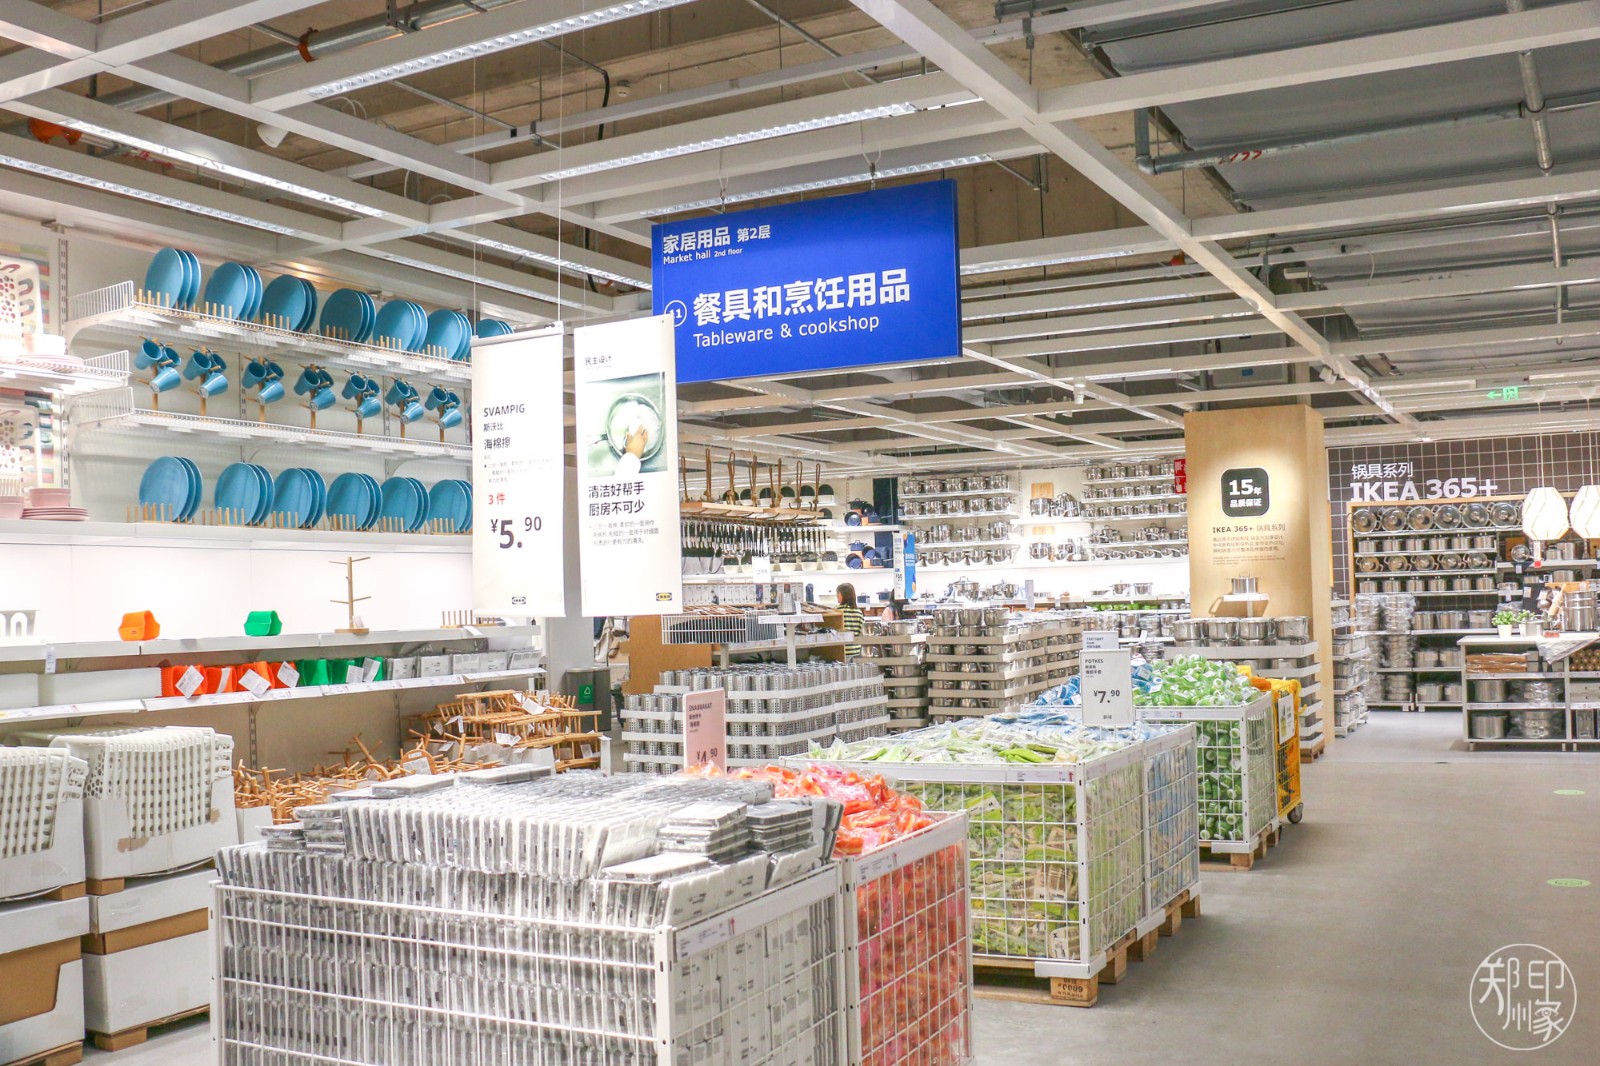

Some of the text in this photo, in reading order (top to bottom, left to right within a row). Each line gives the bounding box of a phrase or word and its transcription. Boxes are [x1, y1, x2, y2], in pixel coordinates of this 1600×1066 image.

[663, 224, 771, 254] 家居用品 第2层
[663, 252, 693, 265] Market
[695, 250, 711, 260] hall
[727, 248, 743, 256] floor
[693, 268, 911, 327] 餐具和烹饪用品
[694, 314, 880, 348] Tableware & cookshop
[483, 403, 526, 418] SVAMPIG
[1351, 461, 1414, 480] 锅具系列
[588, 481, 645, 499] 清洁好帮手
[1350, 477, 1498, 502] IKEA 365+
[588, 499, 646, 517] 厨房不可少
[1212, 526, 1232, 534] IKEA
[1234, 525, 1254, 533] 365+
